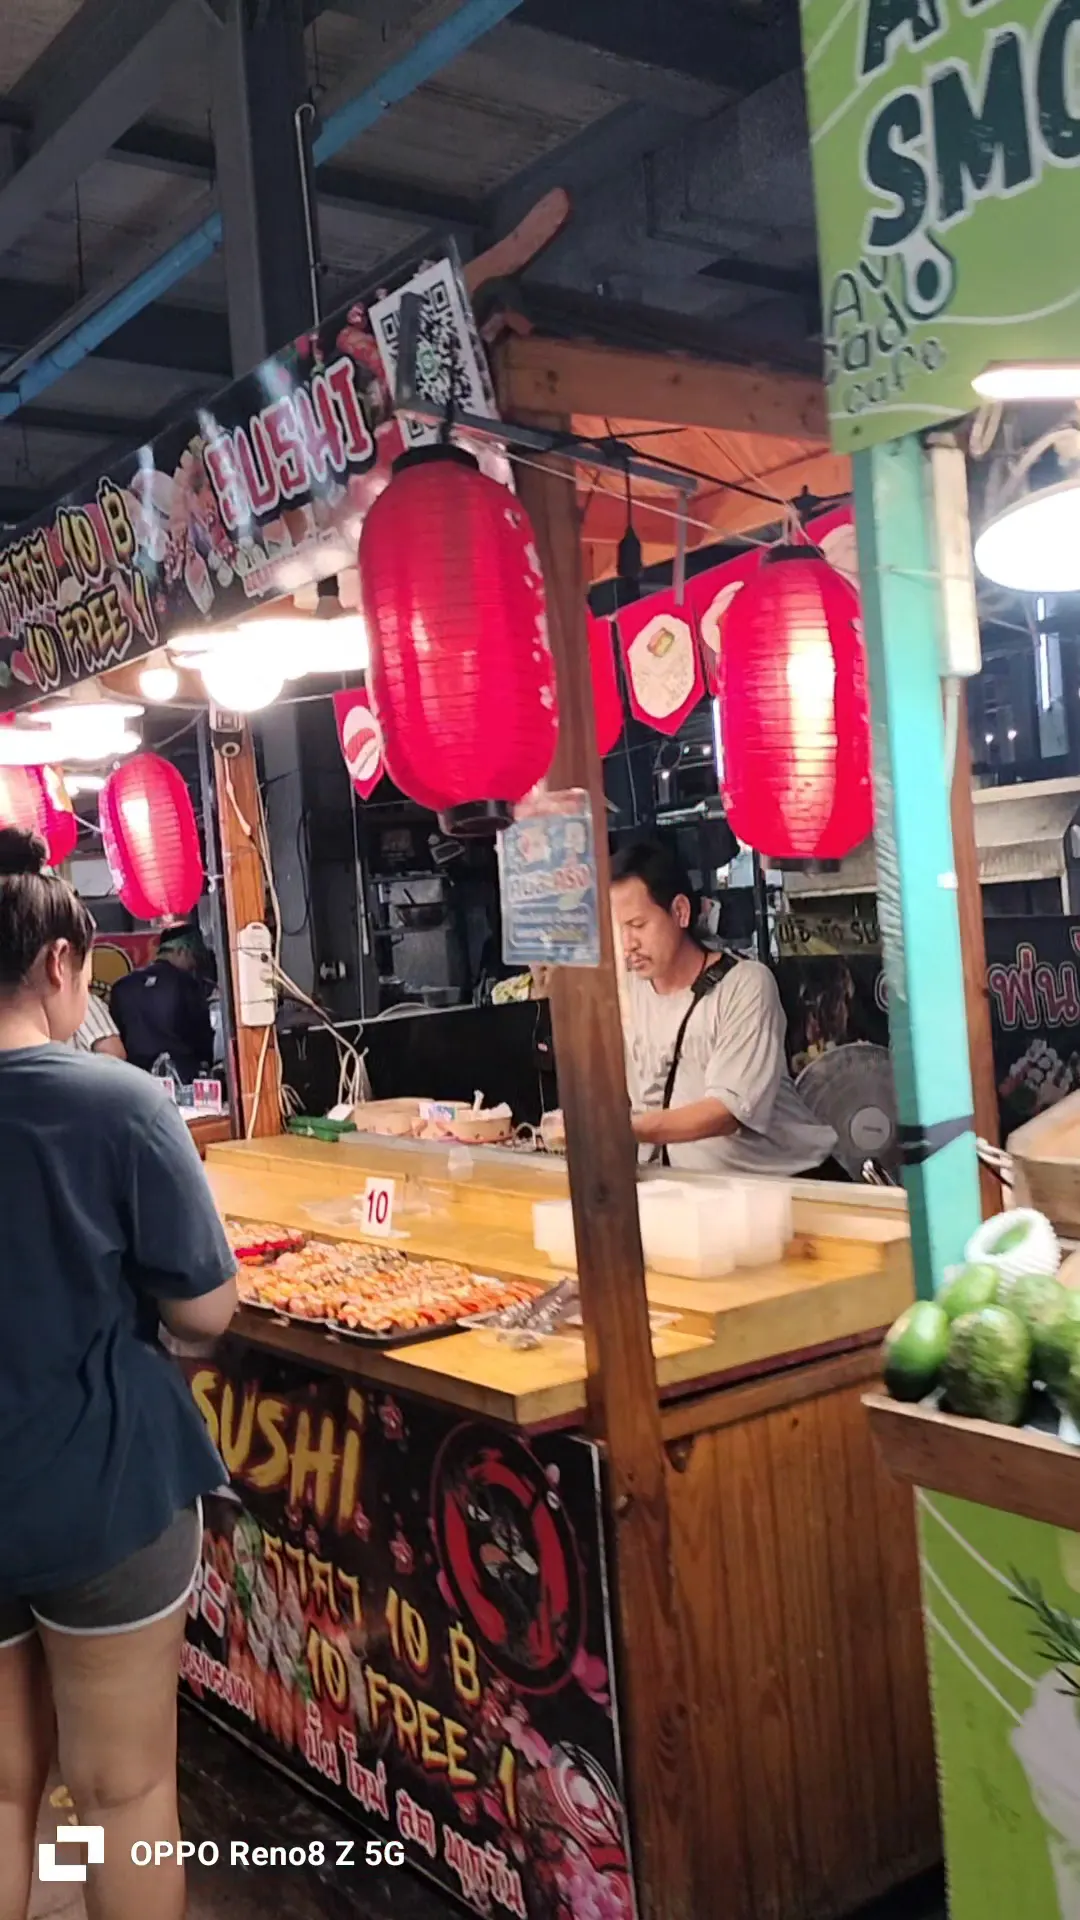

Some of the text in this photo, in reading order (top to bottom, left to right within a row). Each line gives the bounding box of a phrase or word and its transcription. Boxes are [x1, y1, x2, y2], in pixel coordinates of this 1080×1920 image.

[204, 356, 374, 530] SUSHI
[56, 585, 132, 678] FREE
[367, 1188, 389, 1225] 10
[385, 1586, 430, 1676] 10
[307, 1624, 348, 1711] 10
[366, 1664, 478, 1788] FREE
